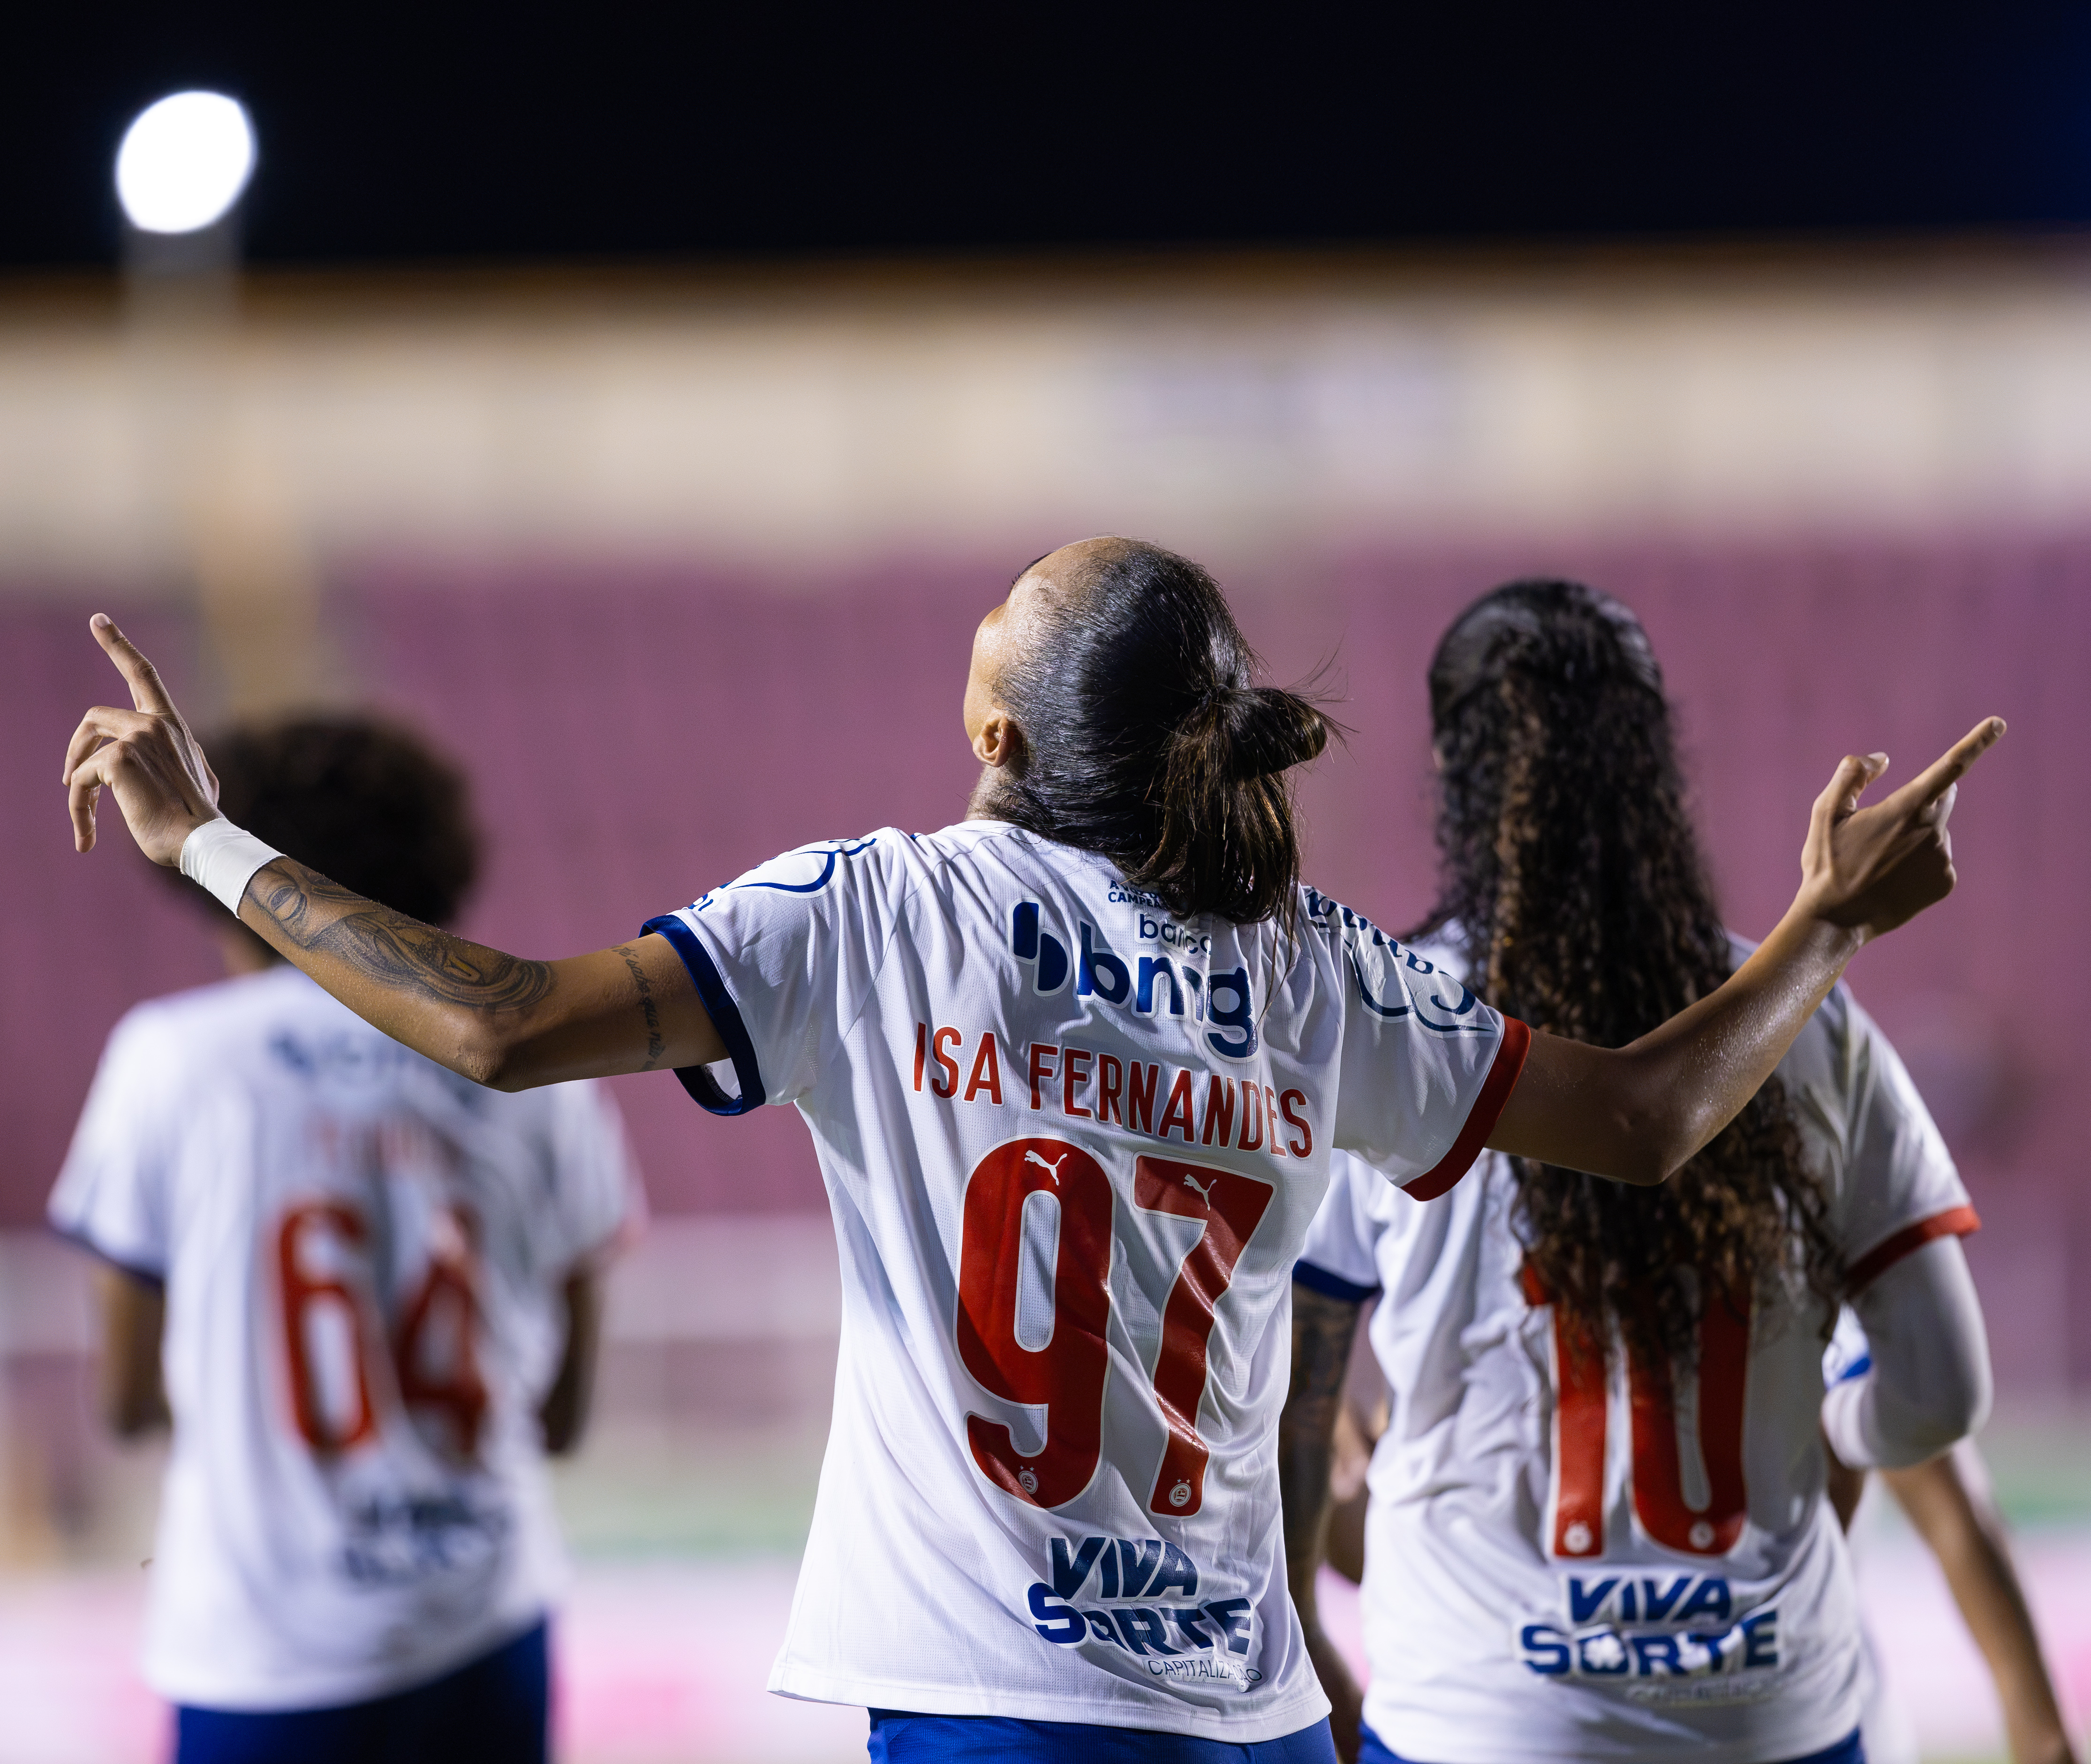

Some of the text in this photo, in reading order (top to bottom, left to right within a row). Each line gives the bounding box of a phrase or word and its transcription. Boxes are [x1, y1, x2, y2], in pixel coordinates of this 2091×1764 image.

[1139, 913, 1212, 955] banco
[1077, 920, 1259, 1058] bmg
[913, 1021, 1313, 1159] ISA FERNANDES
[266, 1199, 490, 1468] 64
[955, 1136, 1276, 1518] 97
[1521, 1257, 1749, 1557] 10
[1027, 1582, 1252, 1656] SORTE
[1050, 1537, 1199, 1600] VIVA
[1569, 1576, 1732, 1622] VIVA
[1521, 1610, 1779, 1675] SORTE
